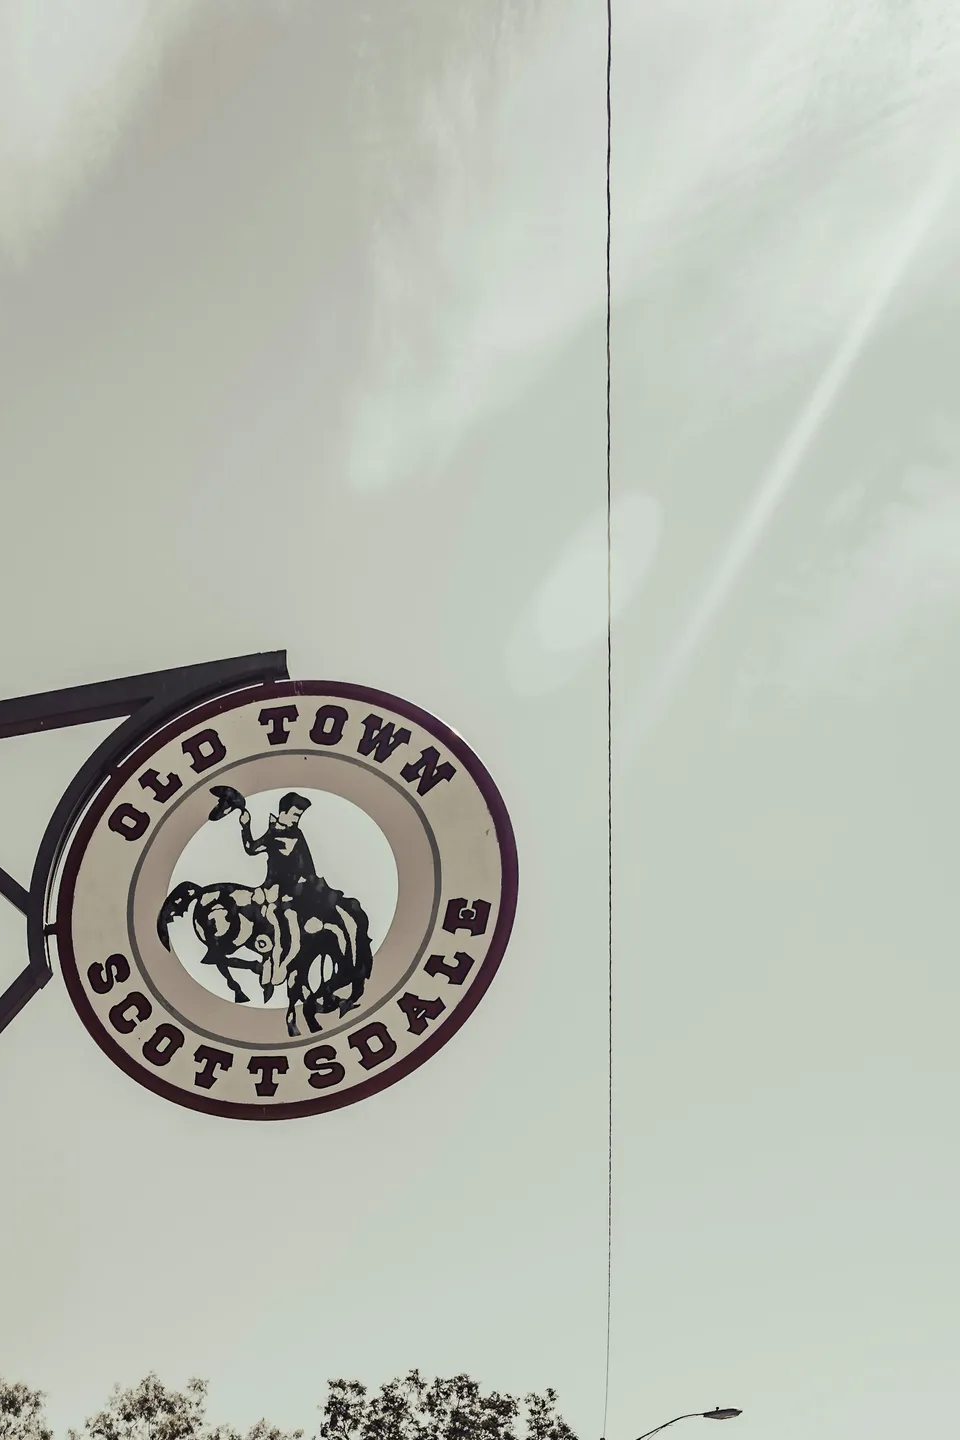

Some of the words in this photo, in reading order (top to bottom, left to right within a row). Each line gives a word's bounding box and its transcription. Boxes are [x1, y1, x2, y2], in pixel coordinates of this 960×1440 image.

[108, 728, 227, 841] OLD
[258, 704, 456, 797] TOWN
[87, 897, 491, 1097] SCOTTSDALE
